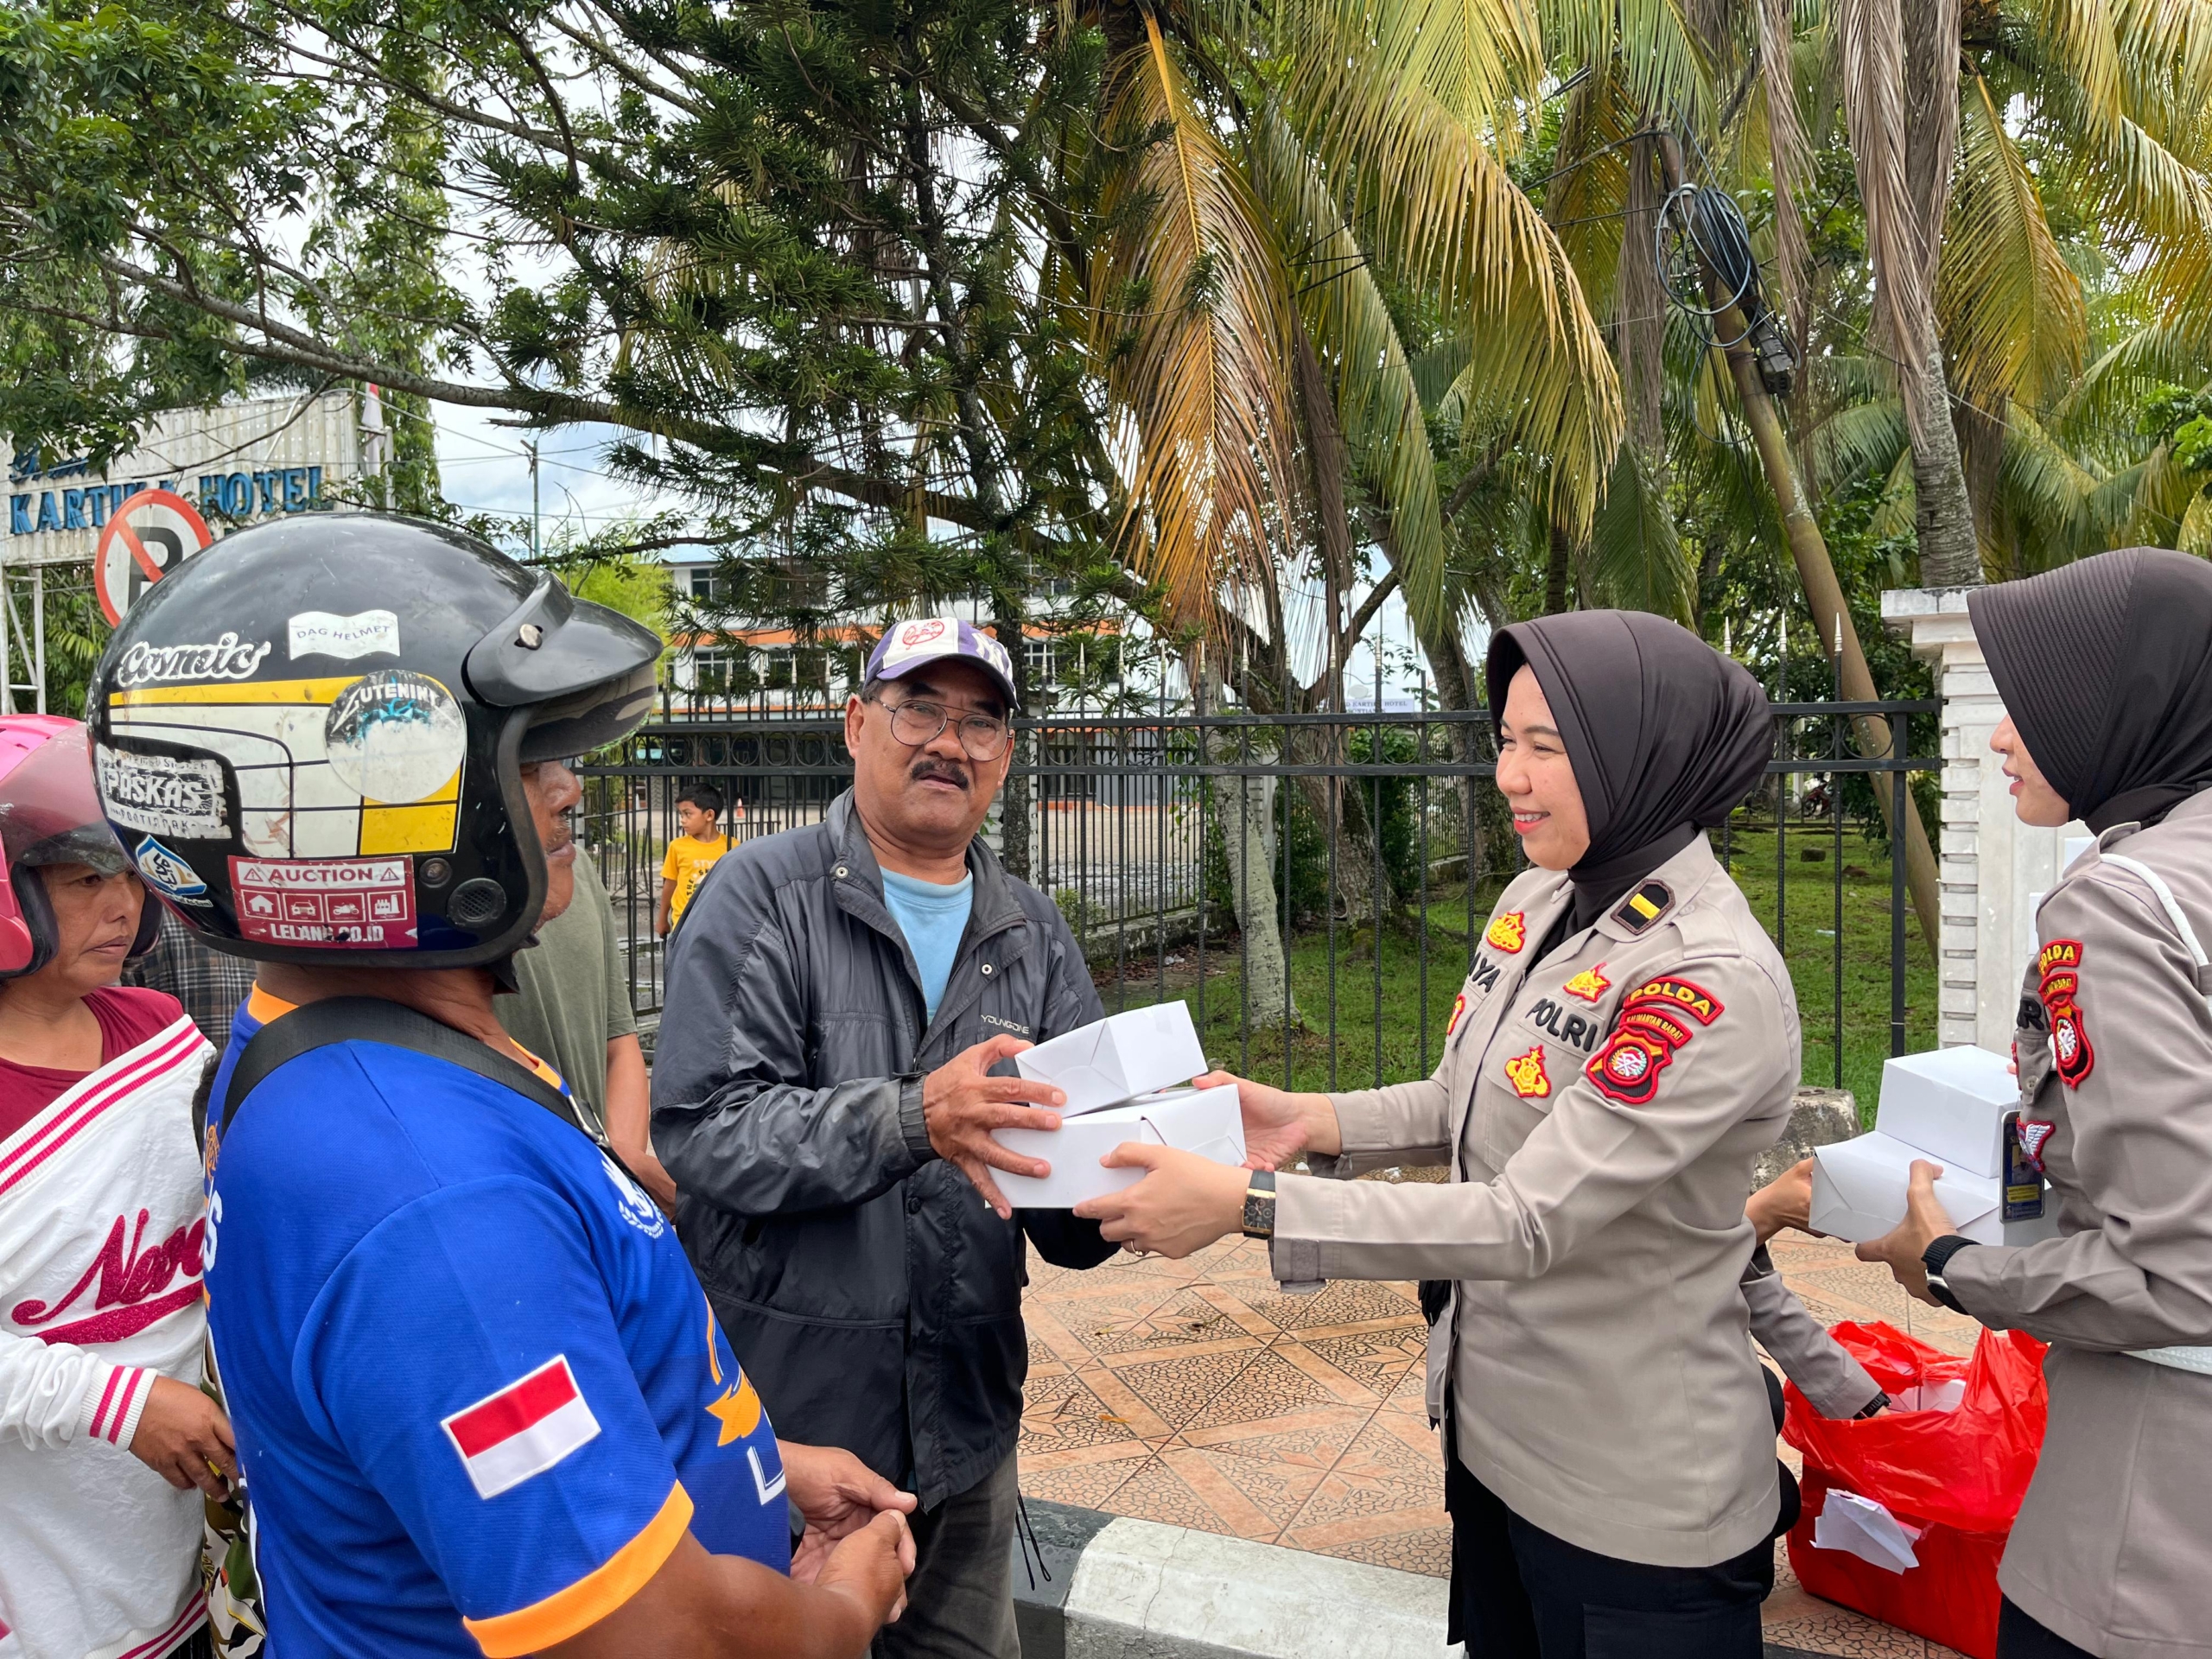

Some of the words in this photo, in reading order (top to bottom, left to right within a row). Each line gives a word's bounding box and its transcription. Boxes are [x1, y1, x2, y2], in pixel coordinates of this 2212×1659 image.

[199, 467, 334, 517] HOTEL
[297, 627, 328, 639] DAG
[333, 625, 391, 641] HELMET
[118, 632, 272, 688] Cosmic
[269, 867, 373, 883] AUCTION
[1630, 982, 1710, 1017] POLDA
[980, 1014, 1031, 1035] YOUNGONE
[1525, 997, 1599, 1052] POLRI
[1661, 1021, 1684, 1040] BARAT
